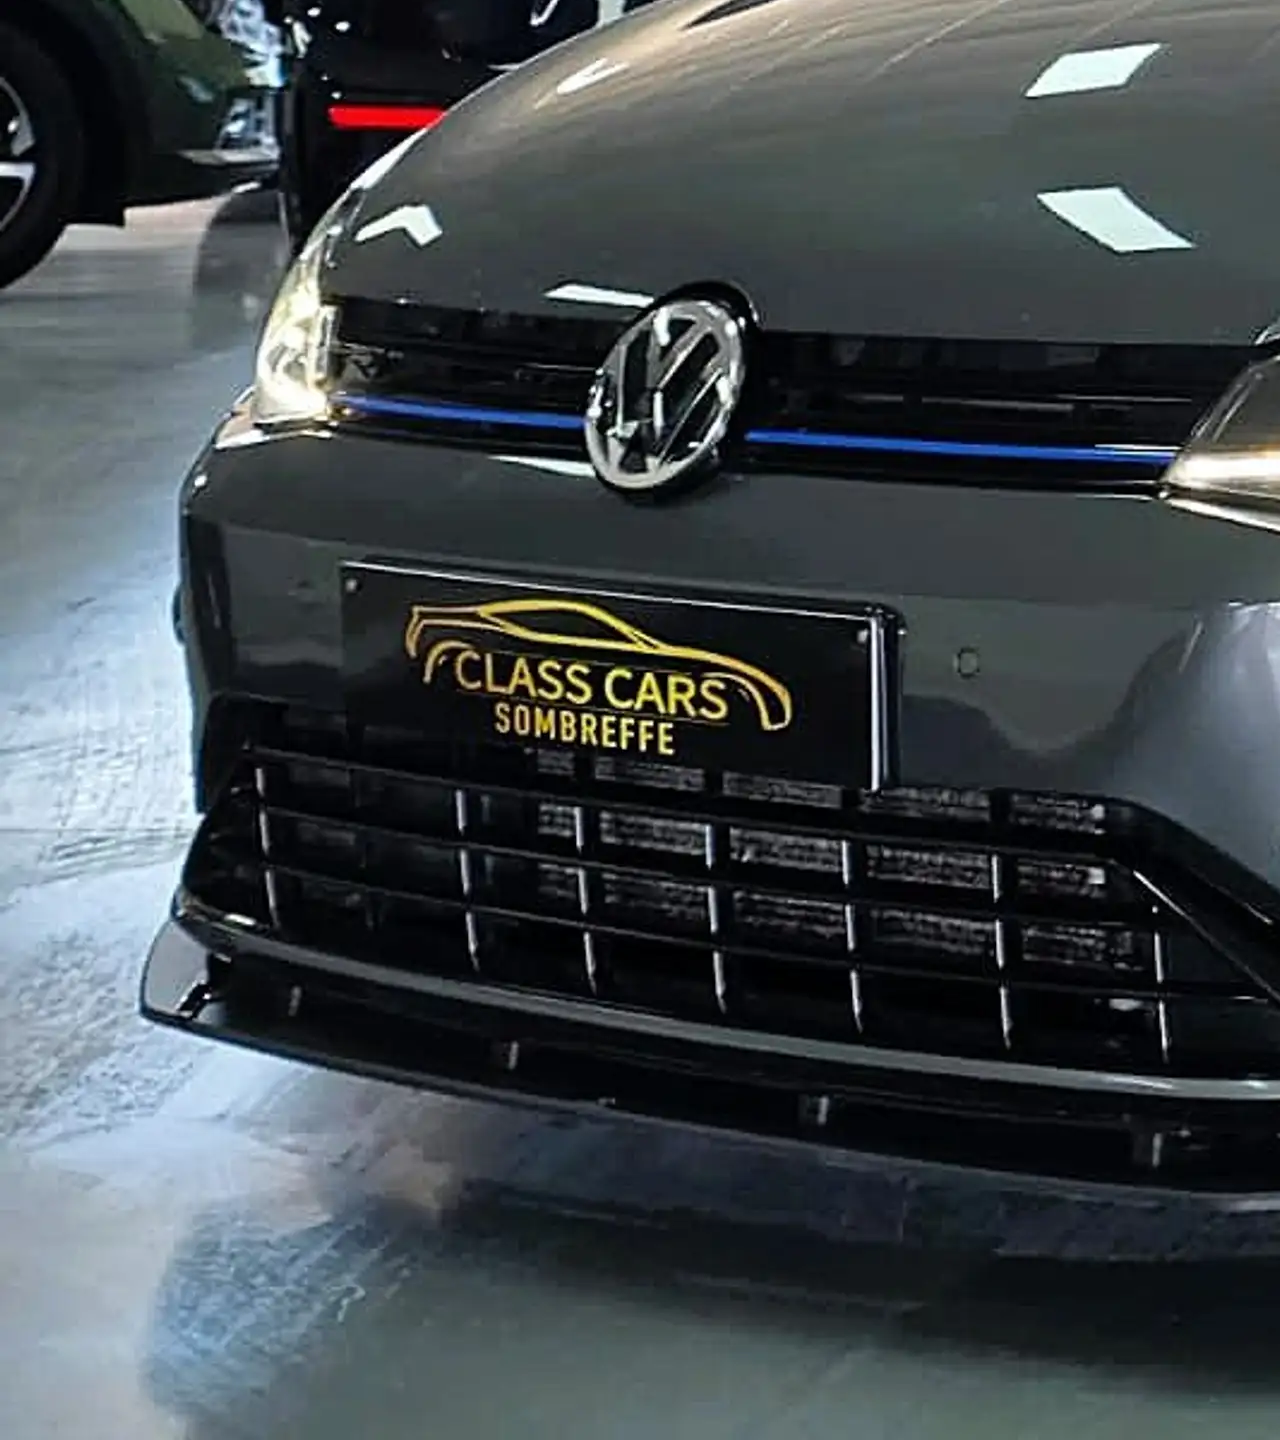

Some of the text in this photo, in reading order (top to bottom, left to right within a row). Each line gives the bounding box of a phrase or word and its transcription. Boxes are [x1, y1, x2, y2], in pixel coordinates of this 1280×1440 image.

[455, 649, 730, 720] CLASS CARS
[493, 702, 676, 756] SOMBREFFE
